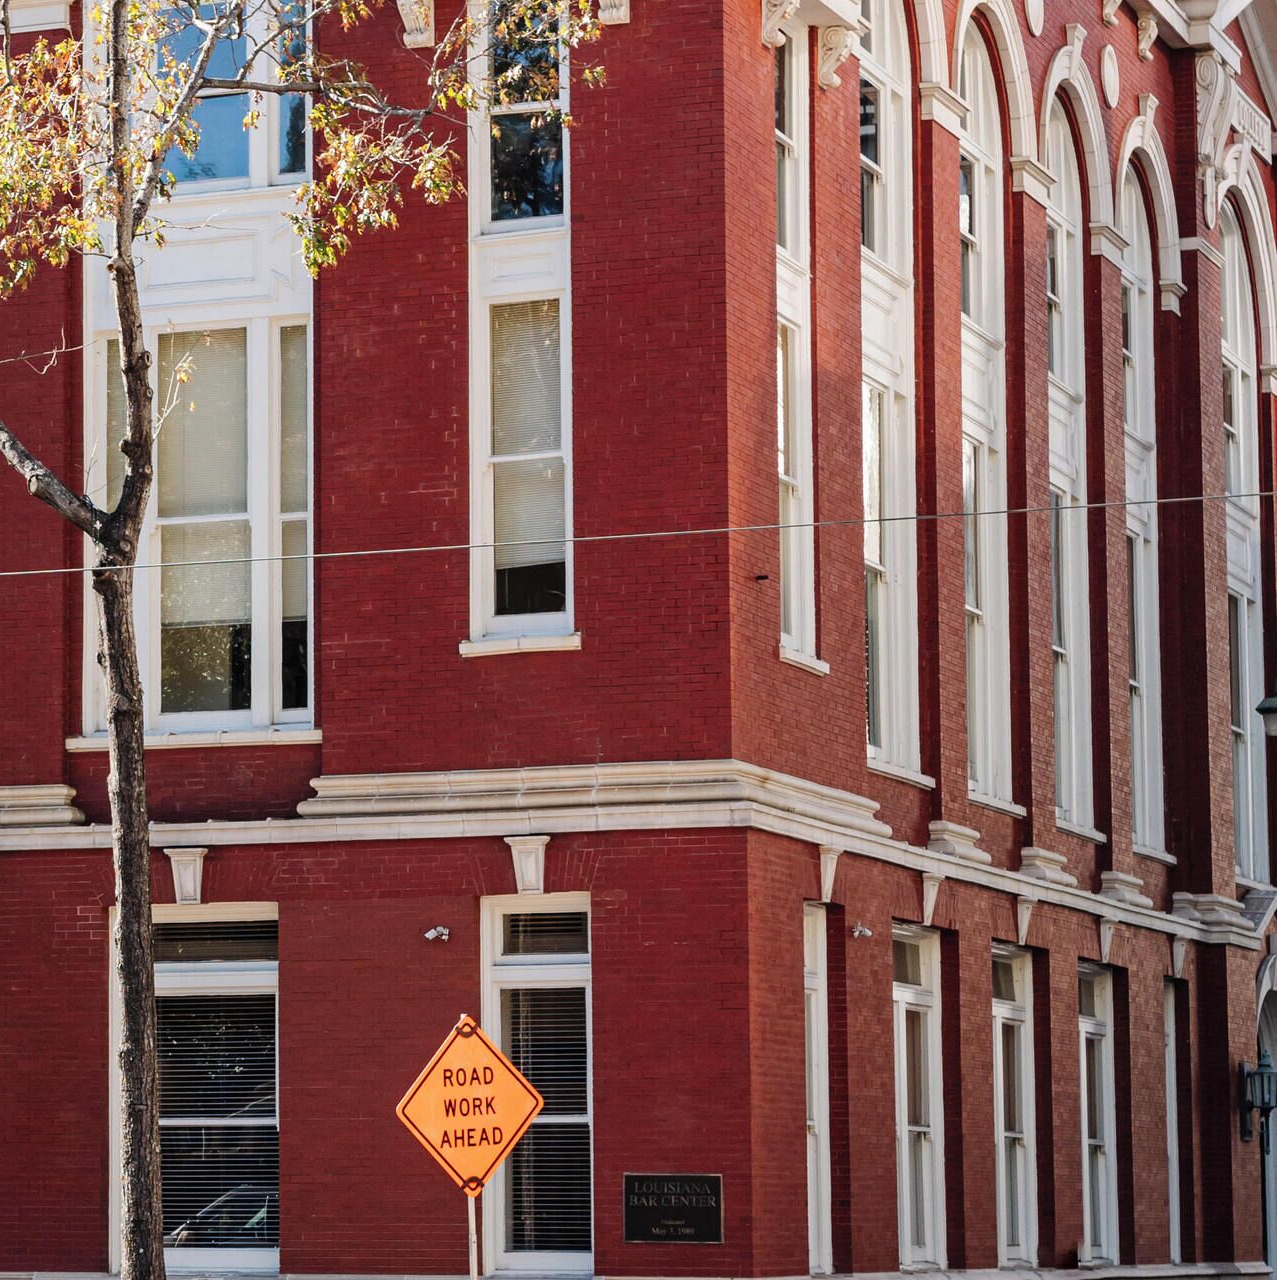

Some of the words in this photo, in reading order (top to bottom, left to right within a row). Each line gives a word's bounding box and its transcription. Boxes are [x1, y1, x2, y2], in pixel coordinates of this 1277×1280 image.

[443, 1066, 494, 1087] ROAD
[443, 1096, 497, 1117] WORK
[440, 1126, 503, 1149] AHEAD
[634, 1182, 711, 1194] LOUISIANA
[629, 1195, 658, 1207] BAR
[661, 1195, 716, 1208] CENTER
